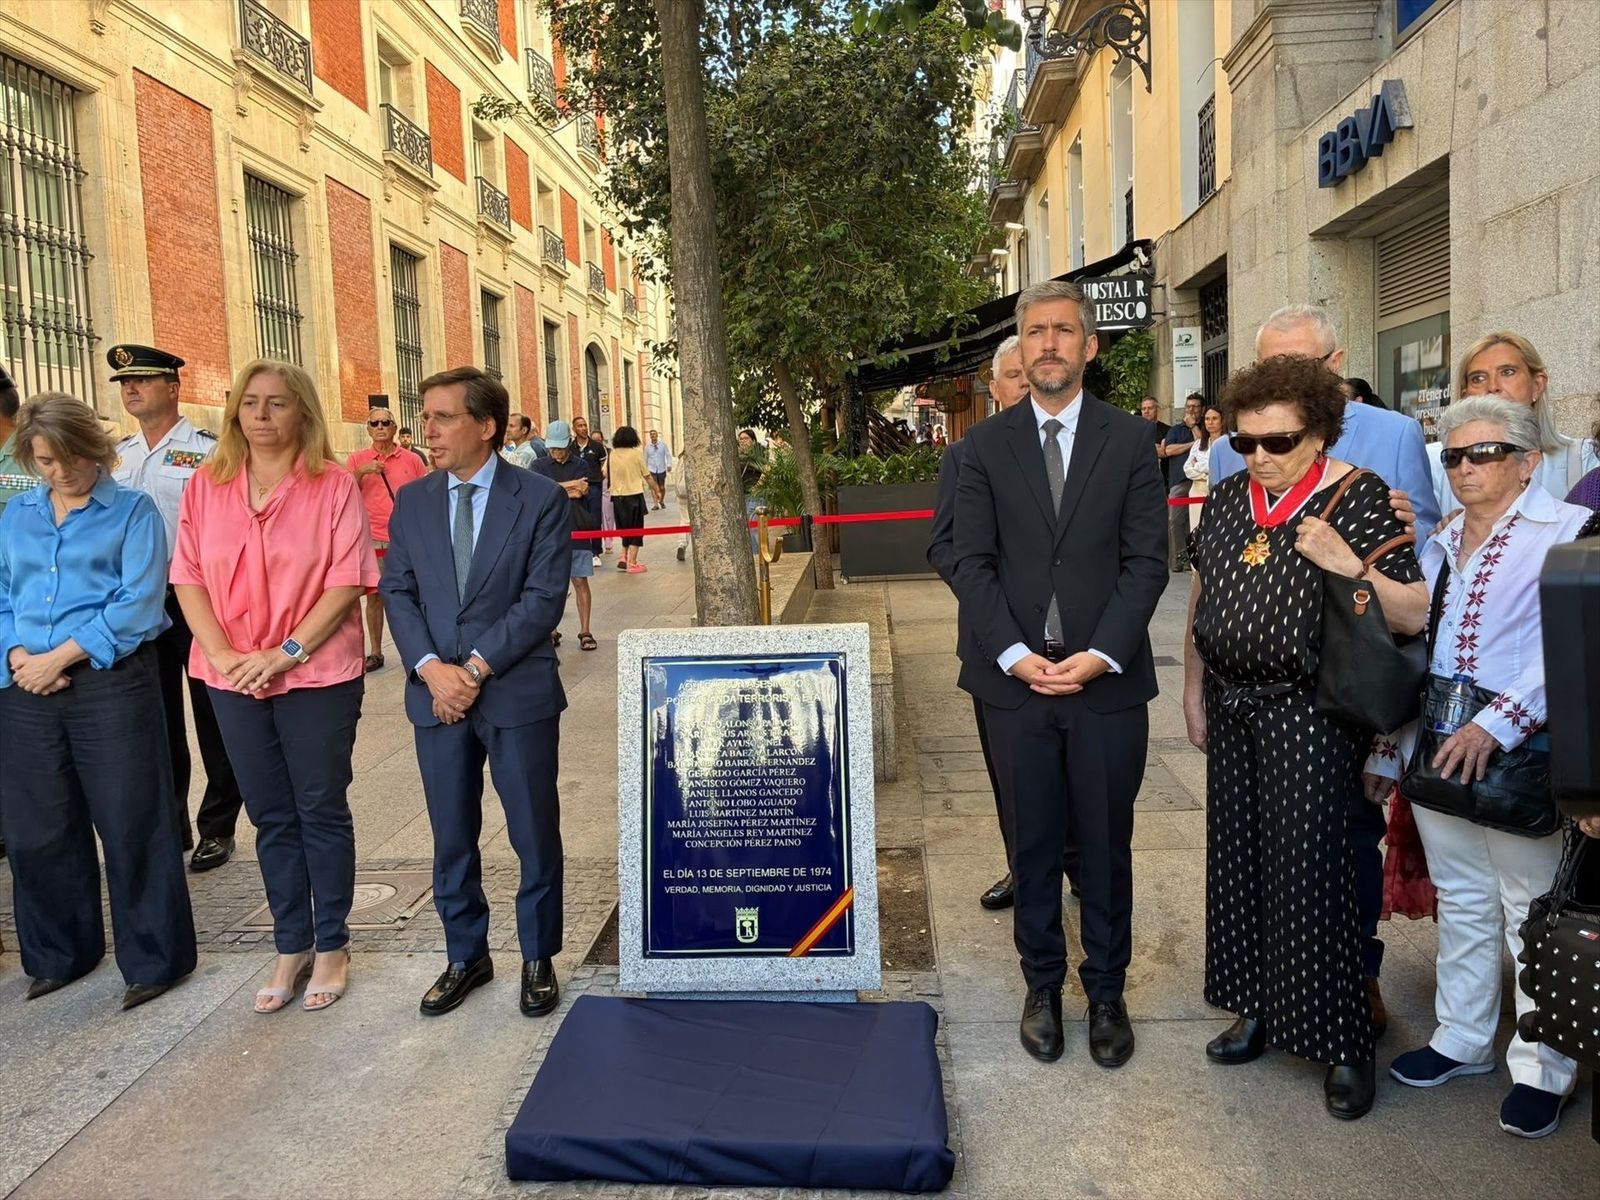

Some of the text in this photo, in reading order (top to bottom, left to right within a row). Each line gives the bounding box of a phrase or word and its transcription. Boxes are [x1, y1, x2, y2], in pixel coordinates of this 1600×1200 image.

[1319, 79, 1413, 188] BBVA
[1083, 280, 1148, 299] HOSTAL R.
[1096, 302, 1147, 322] IESCO
[763, 756, 816, 766] FERNÁNDEZ
[688, 766, 796, 778] GERARDO GARCÍA PÉREZ
[678, 777, 806, 788] FRANCISCO GÓMEZ VAQUERO
[682, 788, 803, 797] MANUEL LLANOS GANCEDO
[731, 799, 756, 807] LOBO
[758, 798, 797, 806] AGUADO
[689, 806, 794, 818] LUIS MARTÍNEZ MARTÍN
[667, 816, 817, 828] MARÍA JOSEFINA PÉREZ MARTÍNEZ
[672, 826, 813, 838] MARÍA ÁNGELES REY MARTÍNEZ
[685, 837, 801, 848] CONCEPCIÓN PÉREZ PAINO
[663, 867, 832, 878] EL DÍA 13 DE SEPTIEMBRE DE 1974
[664, 886, 700, 894] VERDAD,
[702, 885, 743, 893] MEMORIA,
[745, 884, 786, 892] DIGNIDAD
[795, 883, 832, 892] JUSTICIA
